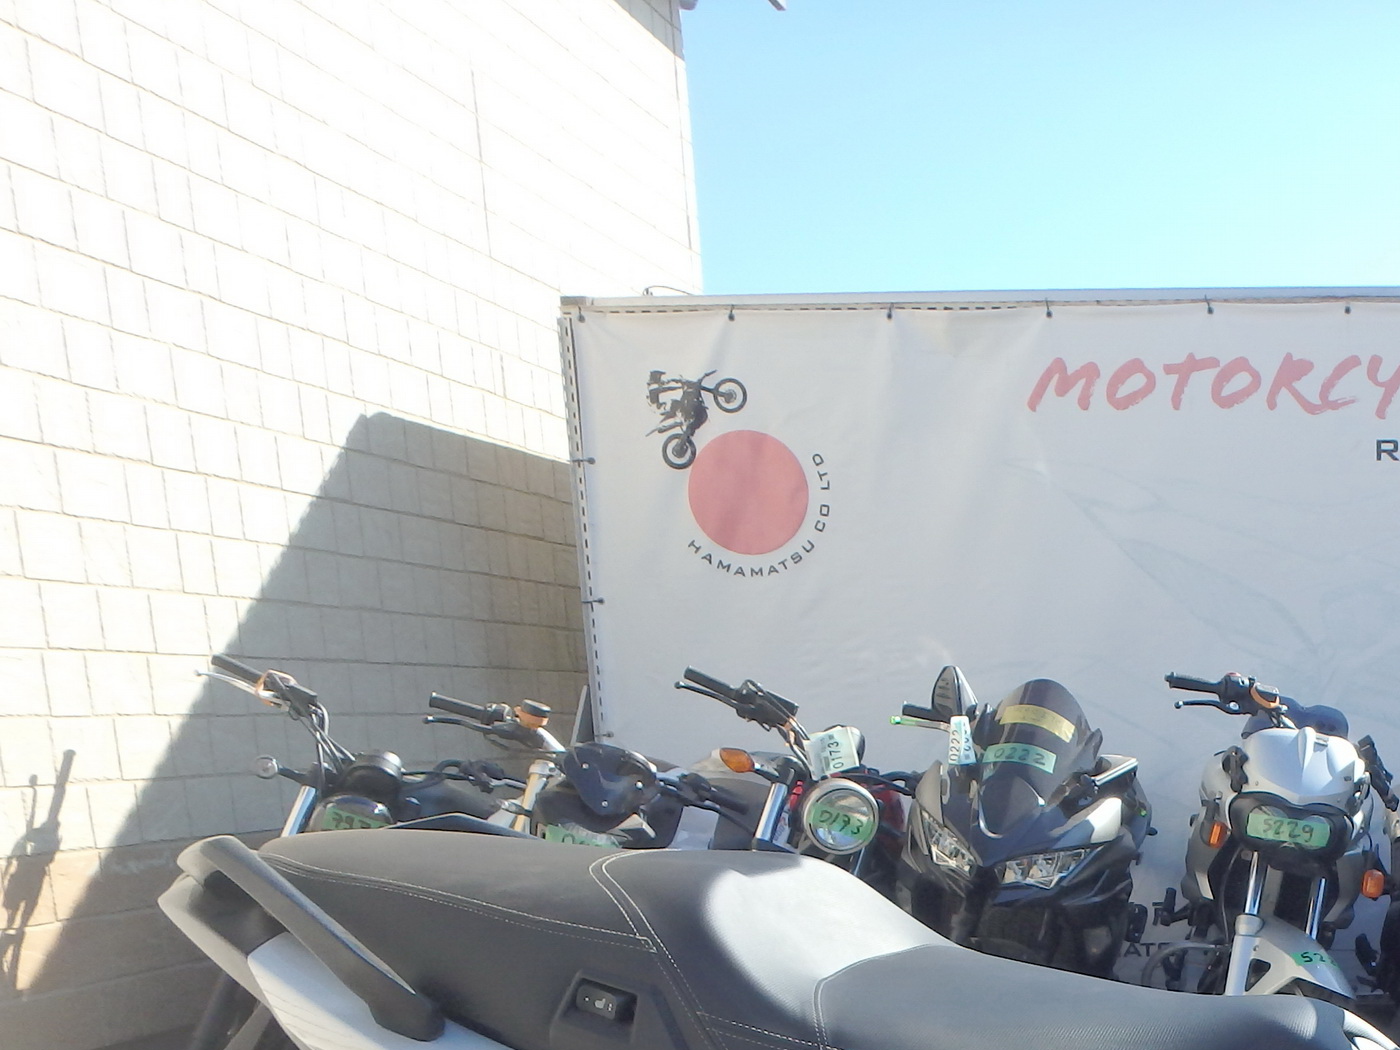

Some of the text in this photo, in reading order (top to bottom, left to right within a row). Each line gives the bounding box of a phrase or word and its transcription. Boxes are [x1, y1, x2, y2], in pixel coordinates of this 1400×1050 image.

[687, 452, 831, 578] HAMAMATSU CO LTD
